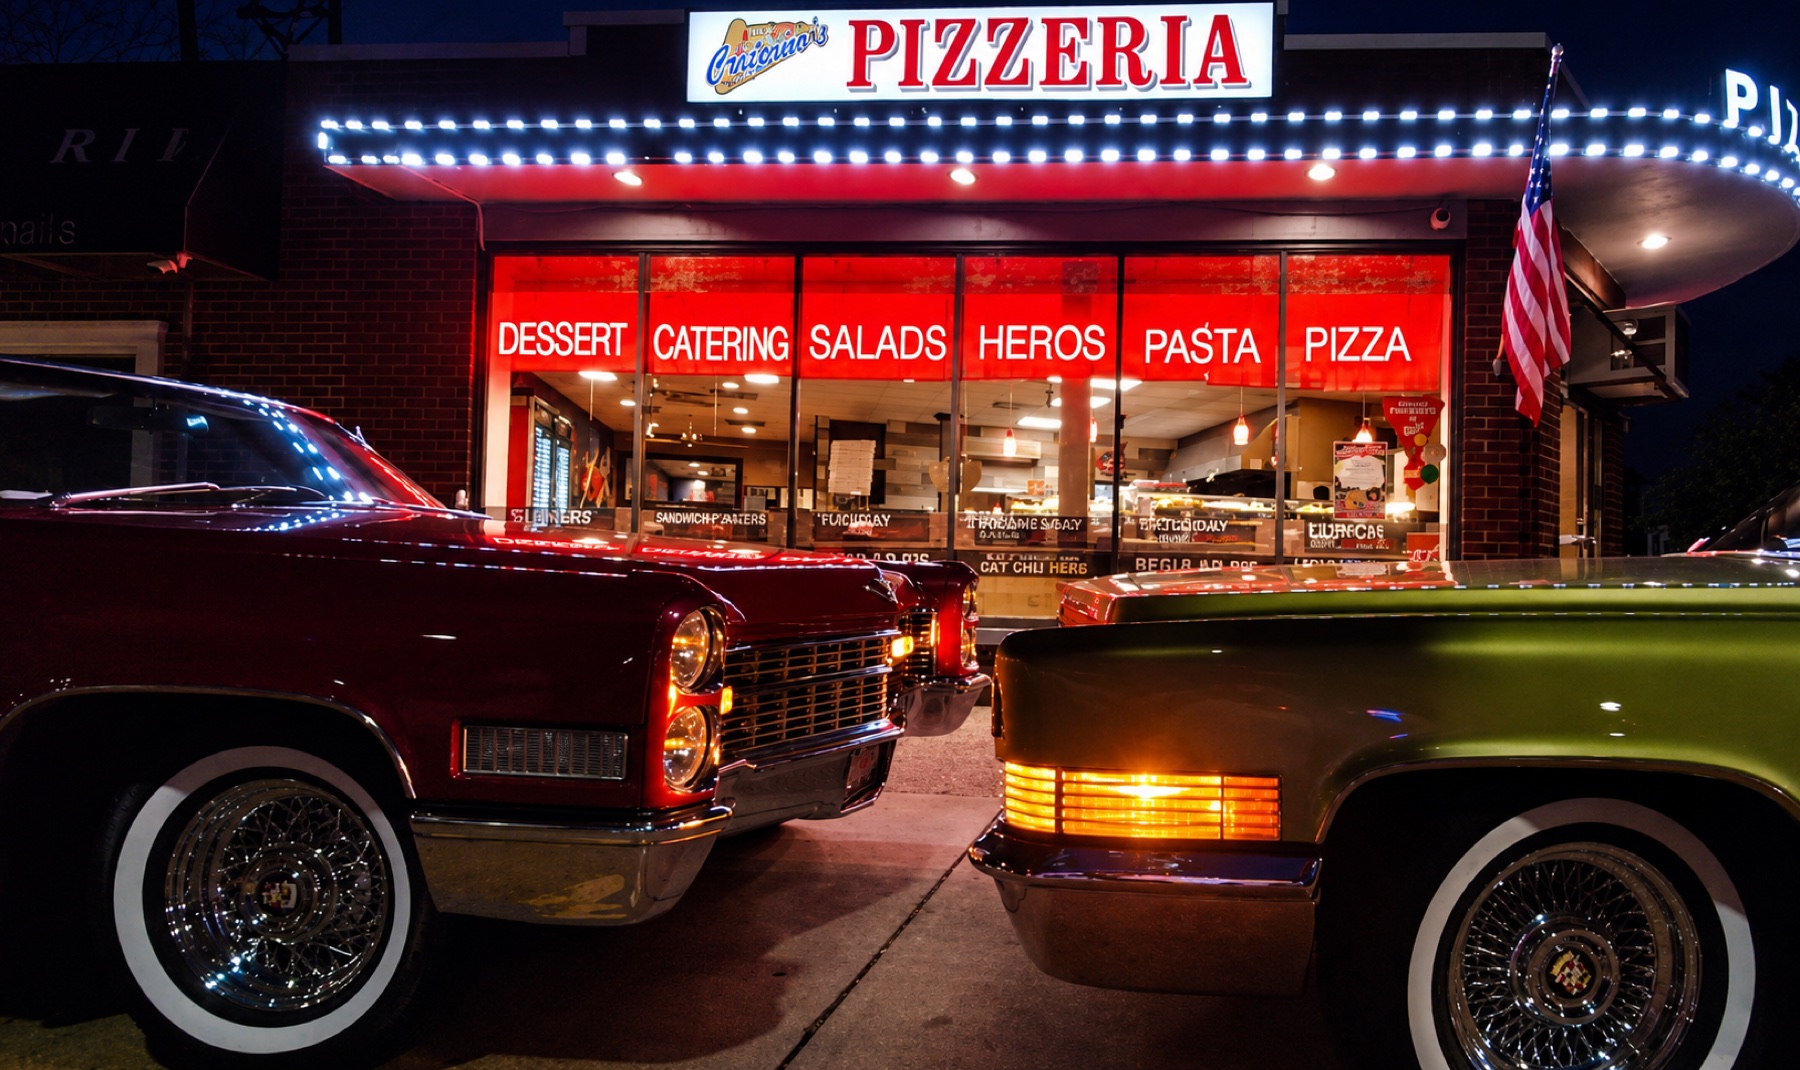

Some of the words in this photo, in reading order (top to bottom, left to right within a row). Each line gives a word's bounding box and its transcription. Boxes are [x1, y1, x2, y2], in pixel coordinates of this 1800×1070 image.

[847, 14, 1251, 92] PIZZERIA
[498, 321, 628, 356] DESSERT
[653, 323, 789, 361] CATERING
[809, 324, 947, 361] SALADS
[979, 324, 1106, 361] HEROS
[1145, 326, 1261, 364] PASTA
[1305, 326, 1412, 362] PIZZA
